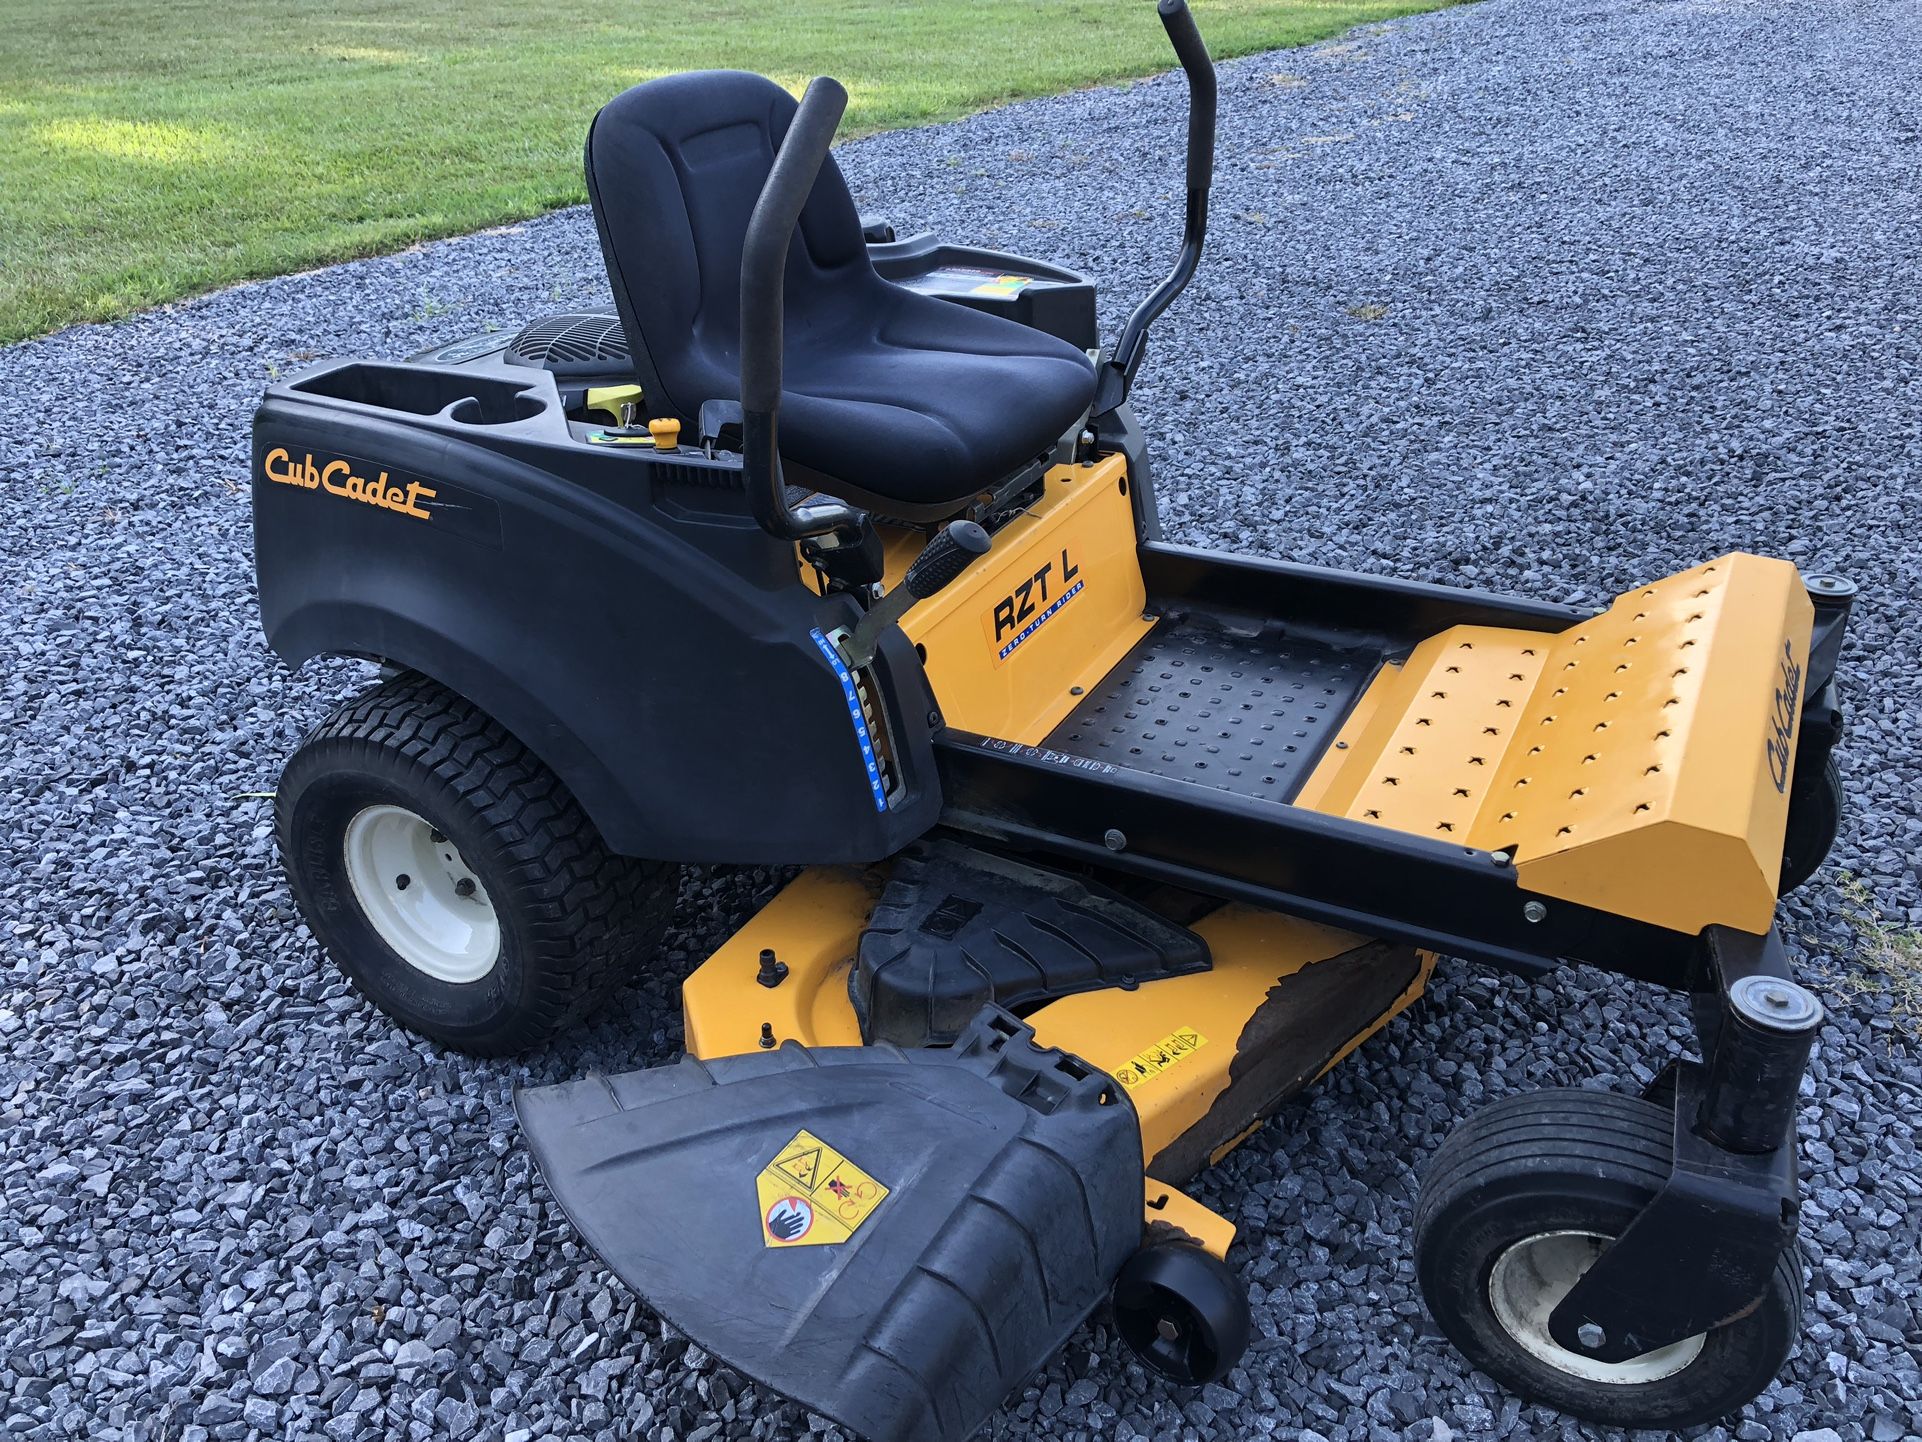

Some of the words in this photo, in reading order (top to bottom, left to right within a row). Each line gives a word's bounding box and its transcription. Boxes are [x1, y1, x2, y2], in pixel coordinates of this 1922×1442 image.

[265, 448, 319, 490] Cub
[322, 460, 437, 520] Cadet
[994, 561, 1052, 643] RZT
[1061, 548, 1079, 584] L
[1001, 609, 1053, 657] ZERO-TURN
[1057, 582, 1083, 608] RIDER
[840, 672, 849, 682] 8
[848, 690, 856, 702] 7
[853, 708, 861, 719] 6
[858, 726, 866, 737] 5
[862, 745, 871, 755] 4
[1767, 715, 1790, 794] Cub
[868, 762, 876, 772] 3
[872, 779, 880, 790] 2
[878, 797, 885, 808] 1
